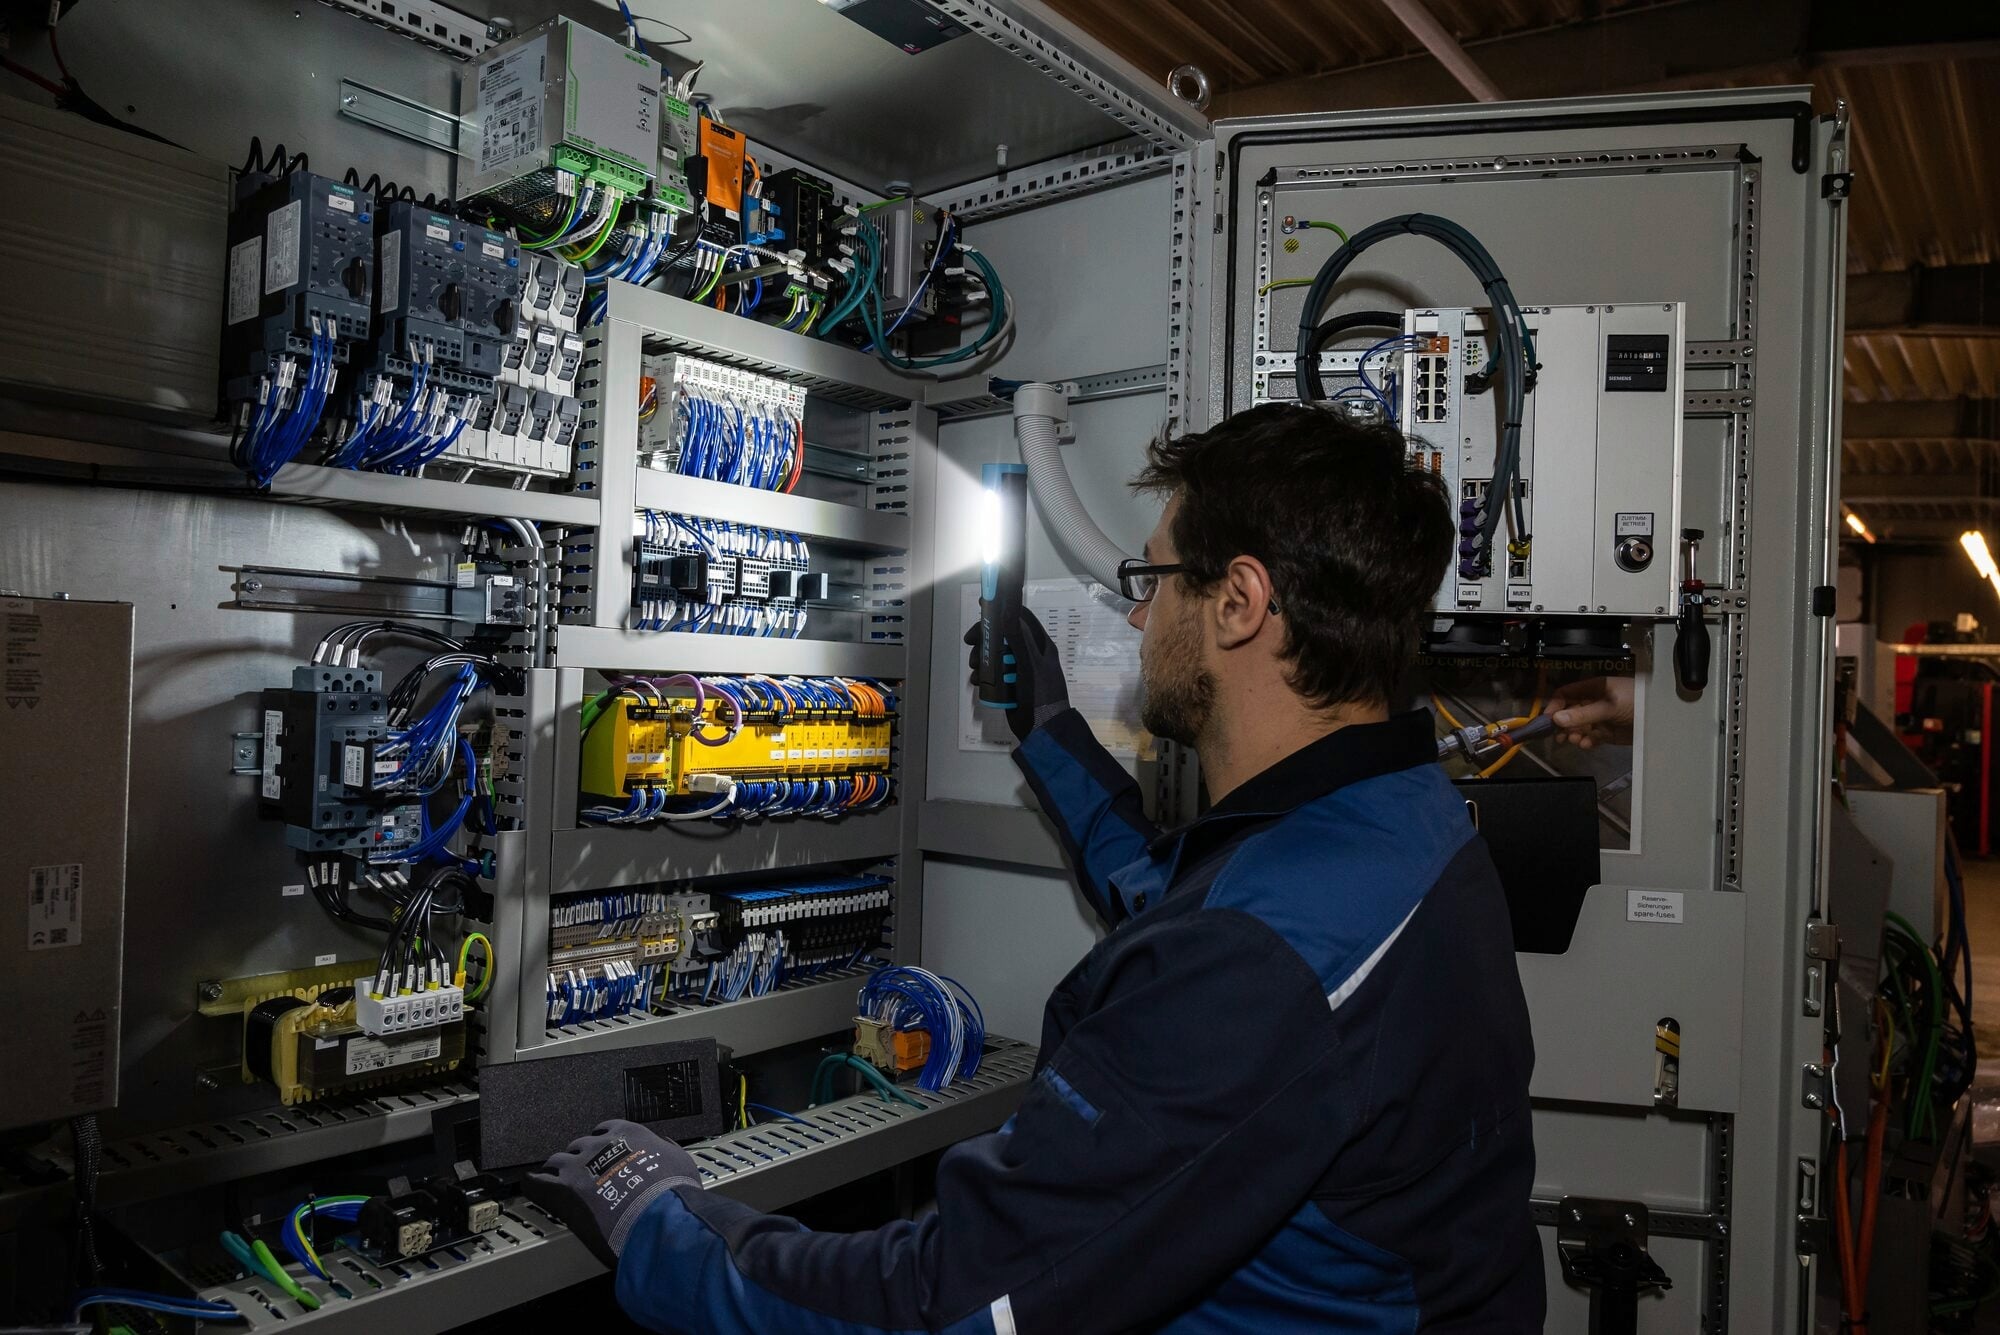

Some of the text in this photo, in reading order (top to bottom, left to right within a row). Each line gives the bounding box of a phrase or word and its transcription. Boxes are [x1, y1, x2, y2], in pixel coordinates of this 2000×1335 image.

[431, 215, 450, 225] SIEMENS
[1438, 656, 1529, 669] CONNECTORS
[1533, 659, 1592, 670] WRENCH
[1597, 660, 1633, 672] TOOL
[1636, 902, 1673, 910] Sicherungen
[1633, 911, 1676, 919] spare-fuses
[590, 1142, 625, 1174] HAZET
